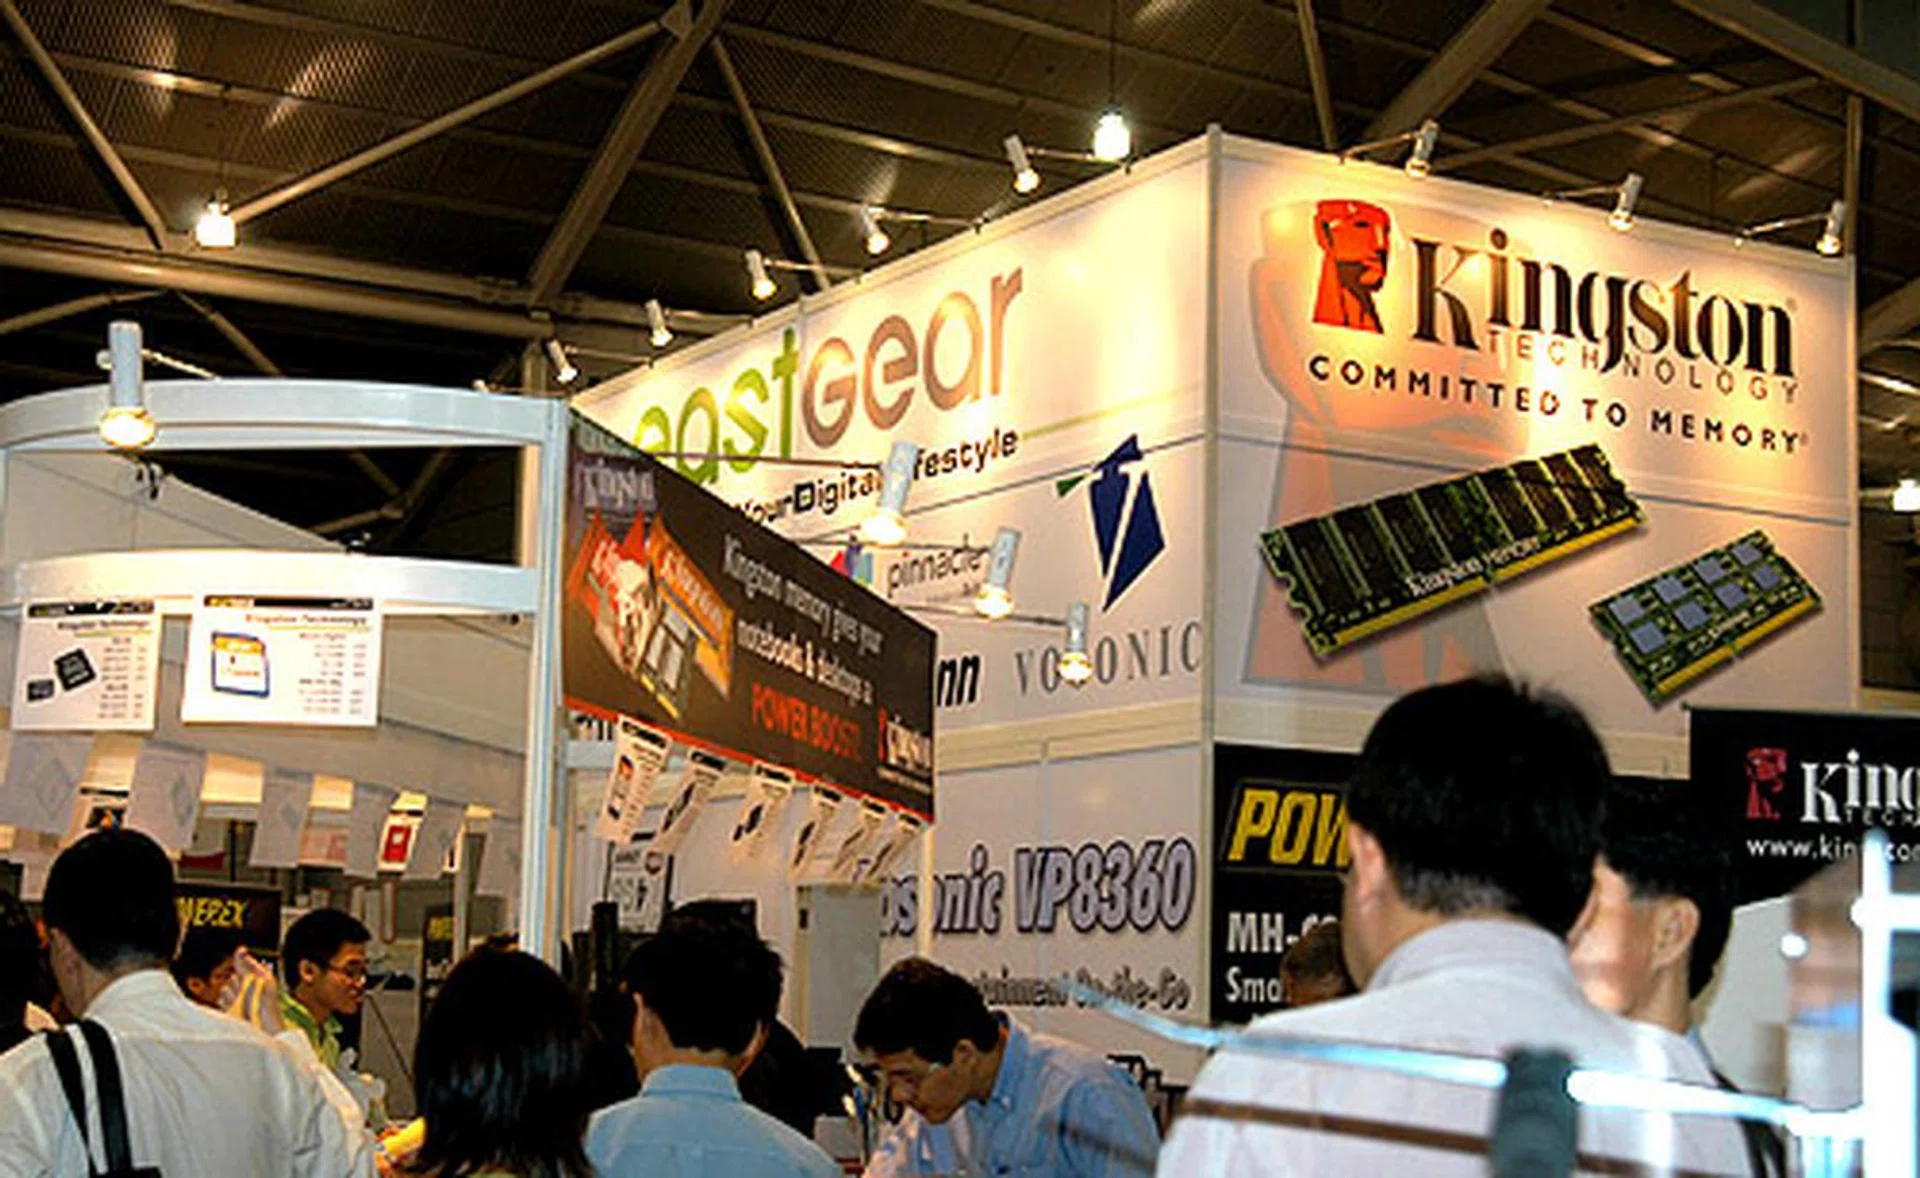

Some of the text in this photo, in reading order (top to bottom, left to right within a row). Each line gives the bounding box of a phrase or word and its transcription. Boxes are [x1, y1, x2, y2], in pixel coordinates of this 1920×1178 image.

[1411, 228, 1796, 377] Kingston
[1309, 355, 1800, 454] COMMITTED TO MEMORY
[1487, 330, 1797, 404] TECHNOLOGY
[1014, 620, 1202, 697] VOONIC
[1014, 837, 1197, 934] VP8360
